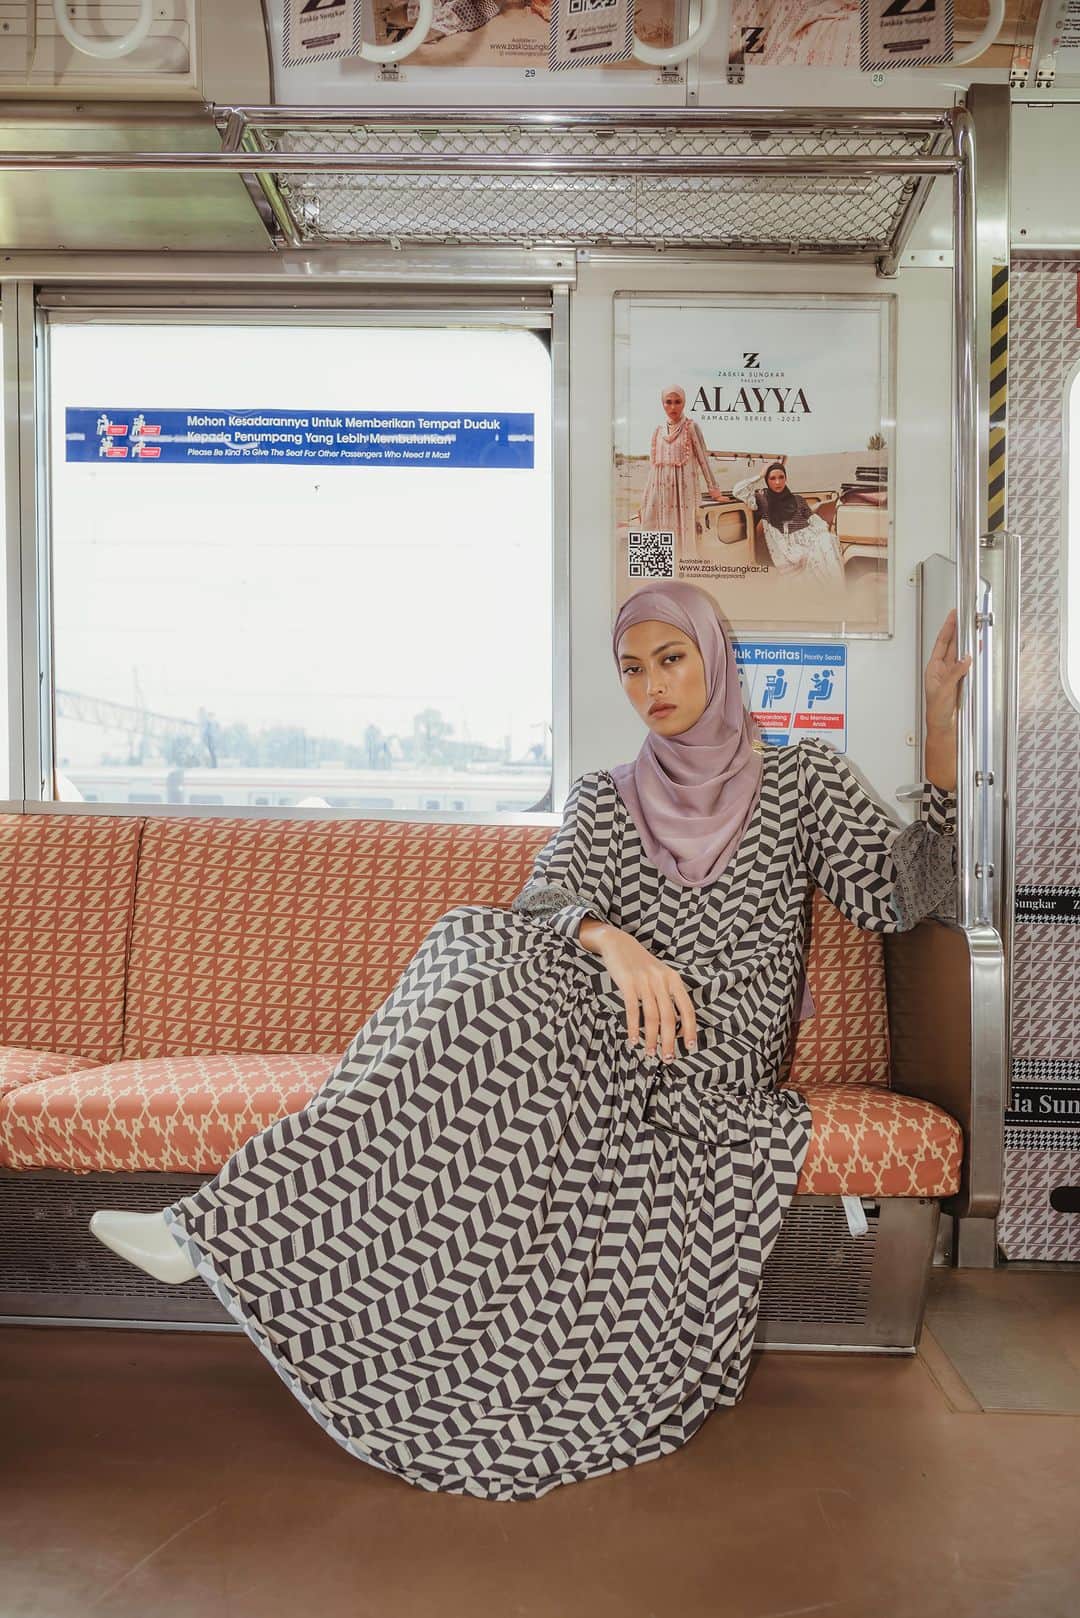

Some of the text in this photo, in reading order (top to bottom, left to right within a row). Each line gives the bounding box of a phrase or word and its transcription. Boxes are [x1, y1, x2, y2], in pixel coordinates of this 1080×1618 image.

[524, 69, 536, 78] 29
[873, 74, 884, 82] 28
[691, 386, 812, 413] ALAYYA
[187, 415, 501, 431] Mohon Kesadarannya Untuk Memberikan Tempat Duduk
[187, 432, 231, 443] Kepada
[234, 432, 302, 444] Penumpang
[305, 433, 333, 445] Yang
[336, 433, 367, 444] Lebih
[187, 448, 212, 457] Please
[213, 449, 223, 457] Be
[224, 449, 241, 457] Kind
[242, 449, 251, 457] To
[252, 449, 269, 457] Give
[271, 449, 285, 457] The
[286, 449, 303, 457] Seat
[304, 450, 316, 458] For
[318, 450, 339, 458] Other
[340, 450, 382, 460] Passengers
[402, 451, 424, 459] Need
[431, 452, 450, 460] Most
[679, 565, 768, 573] www.zaskiasungkar.id
[754, 648, 800, 660] Prioritas
